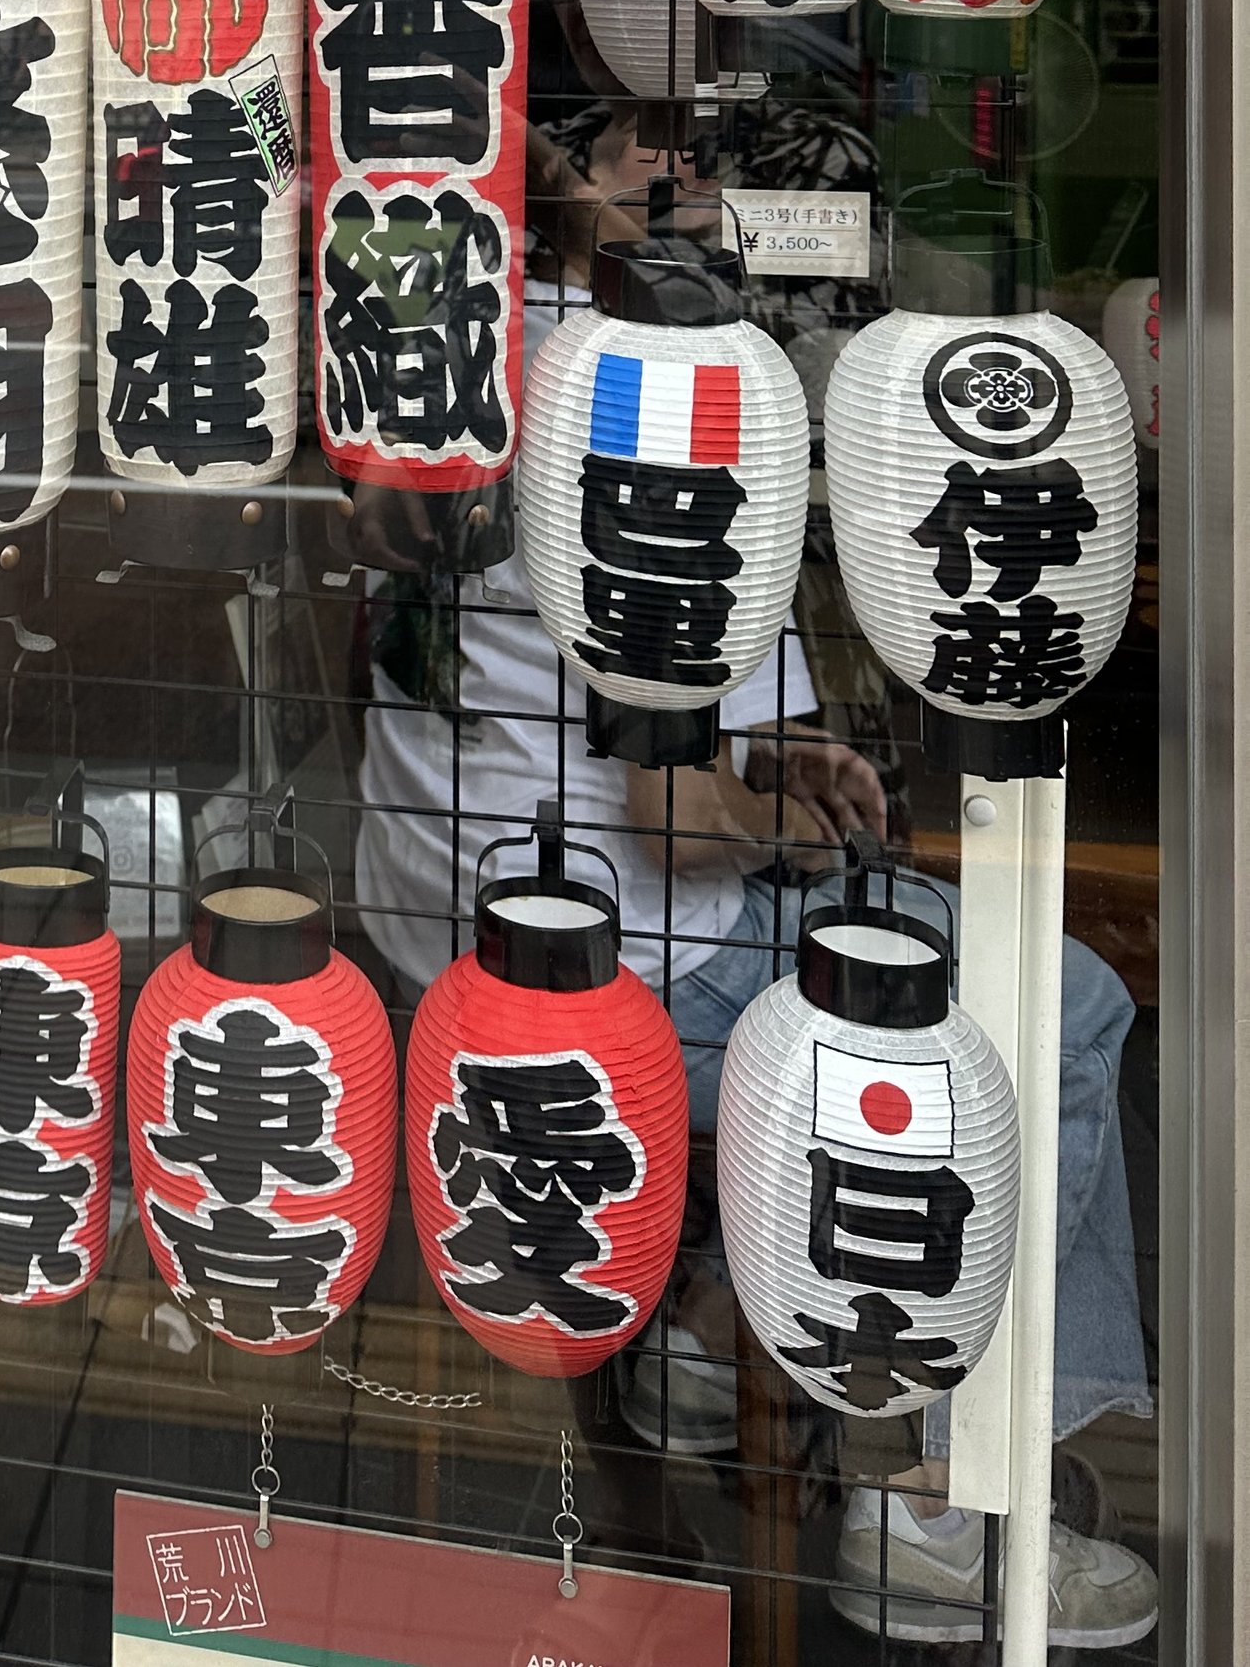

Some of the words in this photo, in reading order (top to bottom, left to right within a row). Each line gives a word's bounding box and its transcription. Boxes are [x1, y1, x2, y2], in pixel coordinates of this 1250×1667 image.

[104, 89, 273, 475] 晴雄
[910, 458, 1098, 708] 伊藤
[149, 1009, 353, 1341] 東京
[776, 1148, 974, 1412] 日本
[164, 1582, 253, 1627] ブランド
